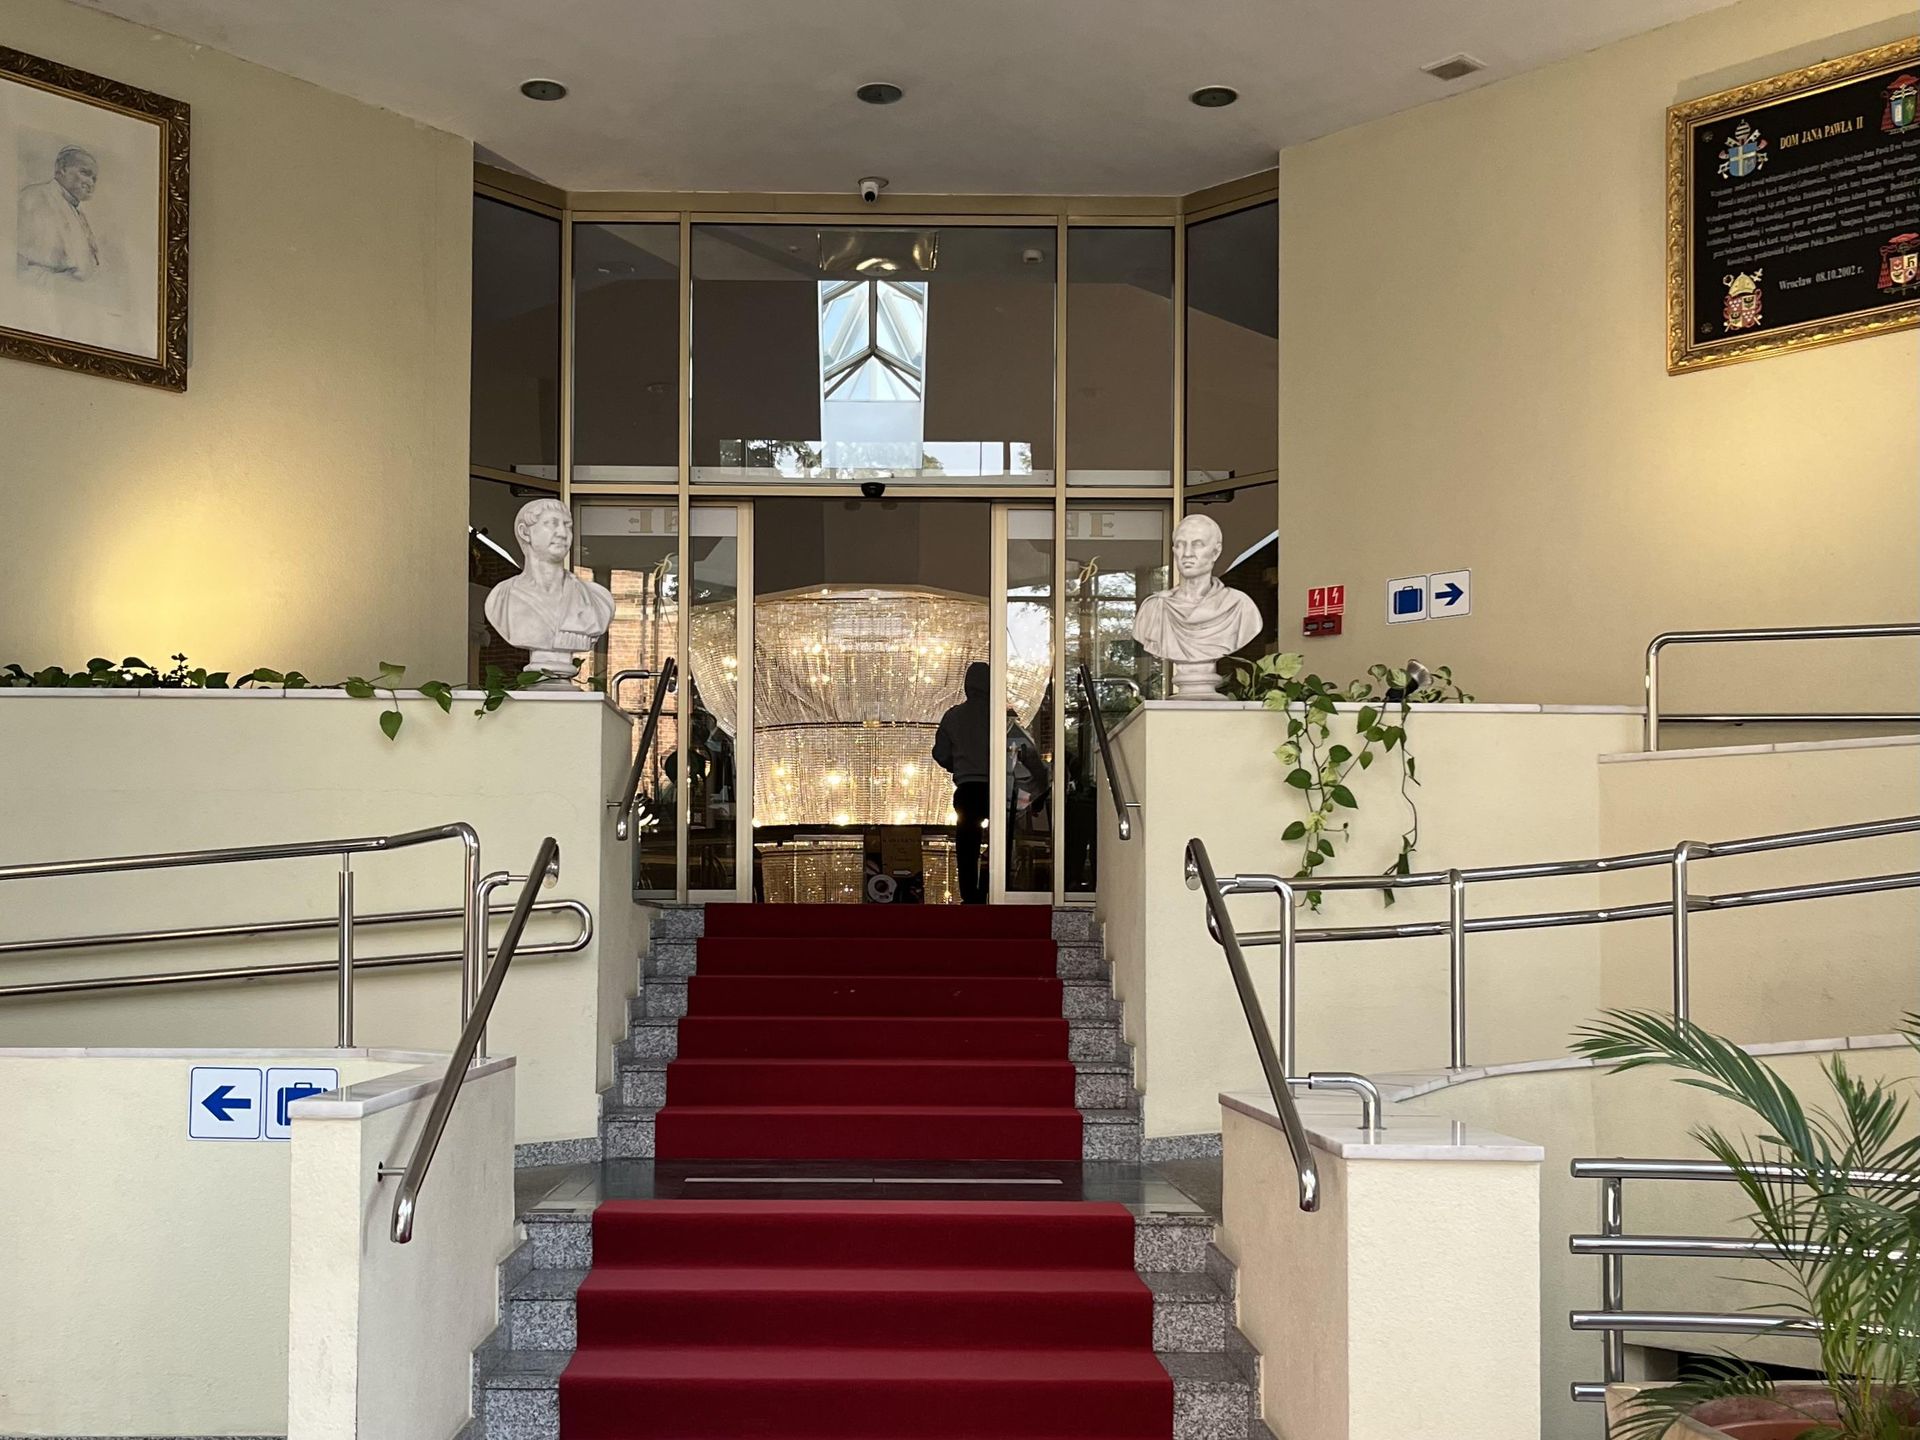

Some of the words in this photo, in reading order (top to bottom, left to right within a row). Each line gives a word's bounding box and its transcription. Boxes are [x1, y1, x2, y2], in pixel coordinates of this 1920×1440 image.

[1780, 133, 1799, 150] DOM
[1801, 127, 1823, 144] JANA
[1856, 116, 1864, 130] II
[1779, 277, 1812, 290] Wrocław
